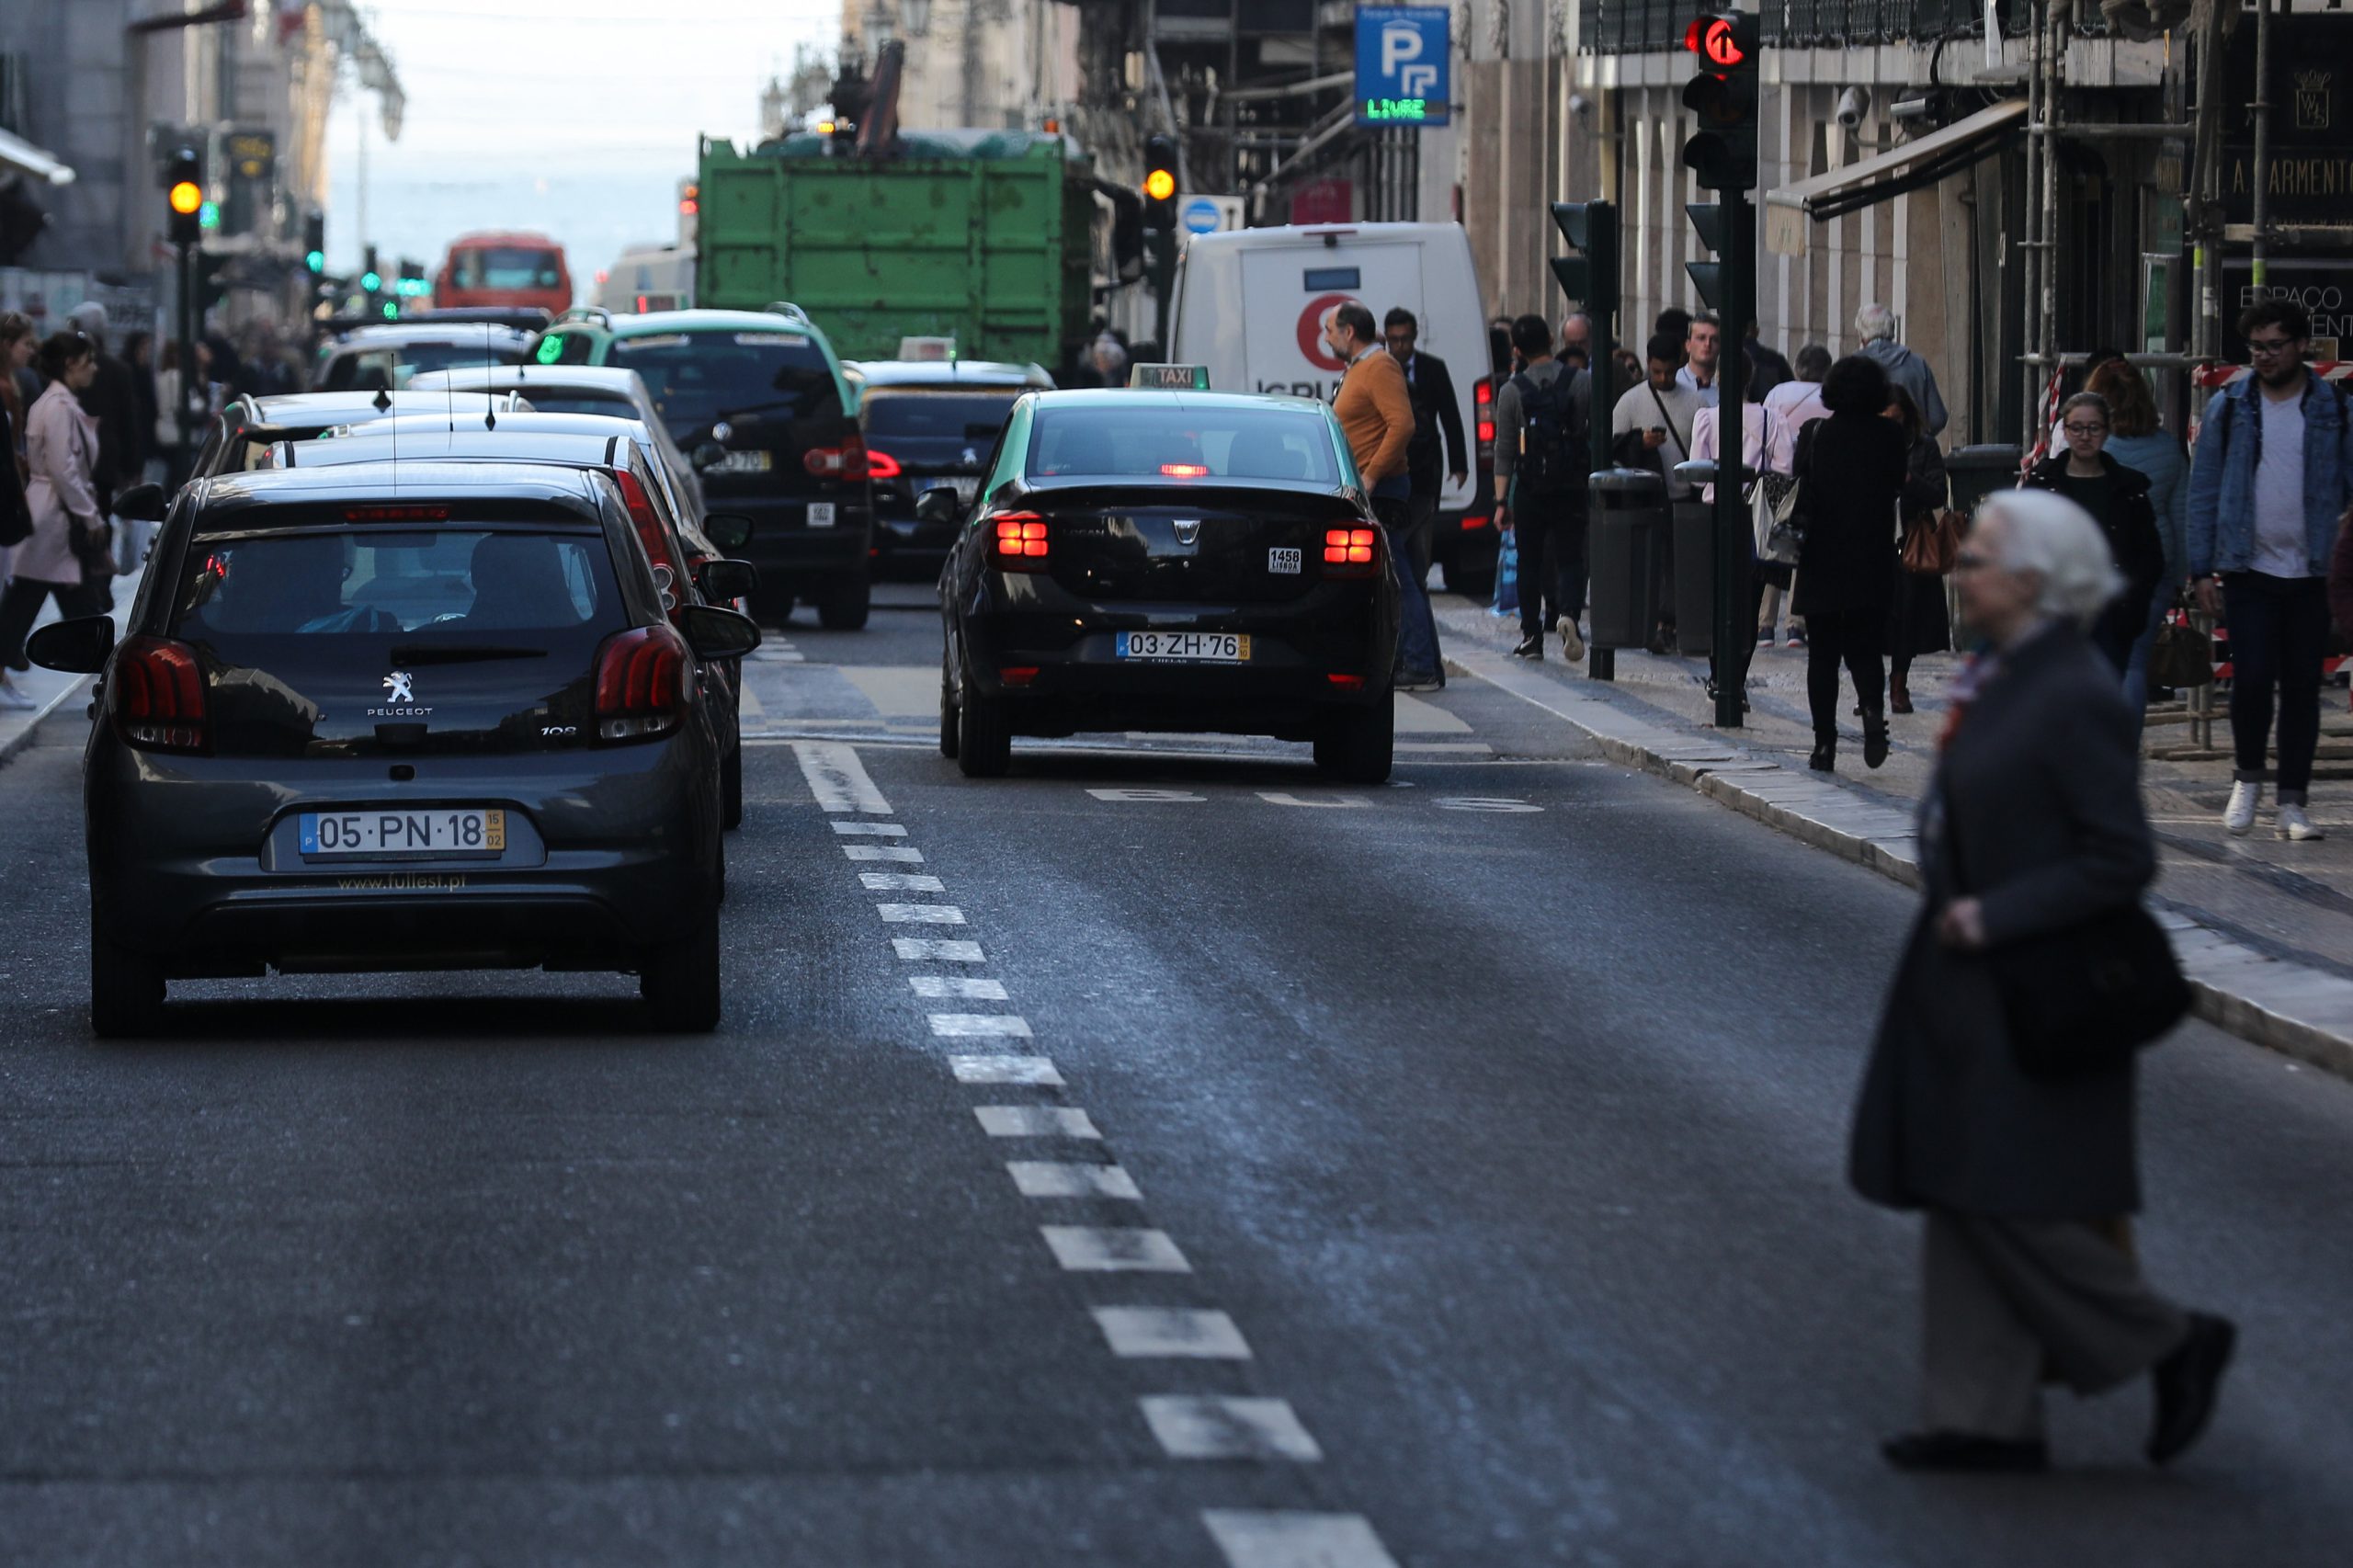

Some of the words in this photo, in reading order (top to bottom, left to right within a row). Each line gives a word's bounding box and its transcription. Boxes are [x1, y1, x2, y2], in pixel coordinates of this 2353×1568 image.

[1381, 28, 1423, 77] P
[1367, 98, 1426, 119] LIVRE
[2257, 158, 2353, 195] ARMENT
[2240, 286, 2341, 313] EPAÇO
[1157, 368, 1192, 383] TAXI
[1271, 550, 1300, 562] 1458
[367, 708, 433, 717] PEUGEOT
[540, 726, 577, 736] 108
[489, 814, 499, 824] 15
[305, 837, 313, 846] P
[487, 835, 502, 846] 02
[337, 870, 467, 892] www.fullest.pt
